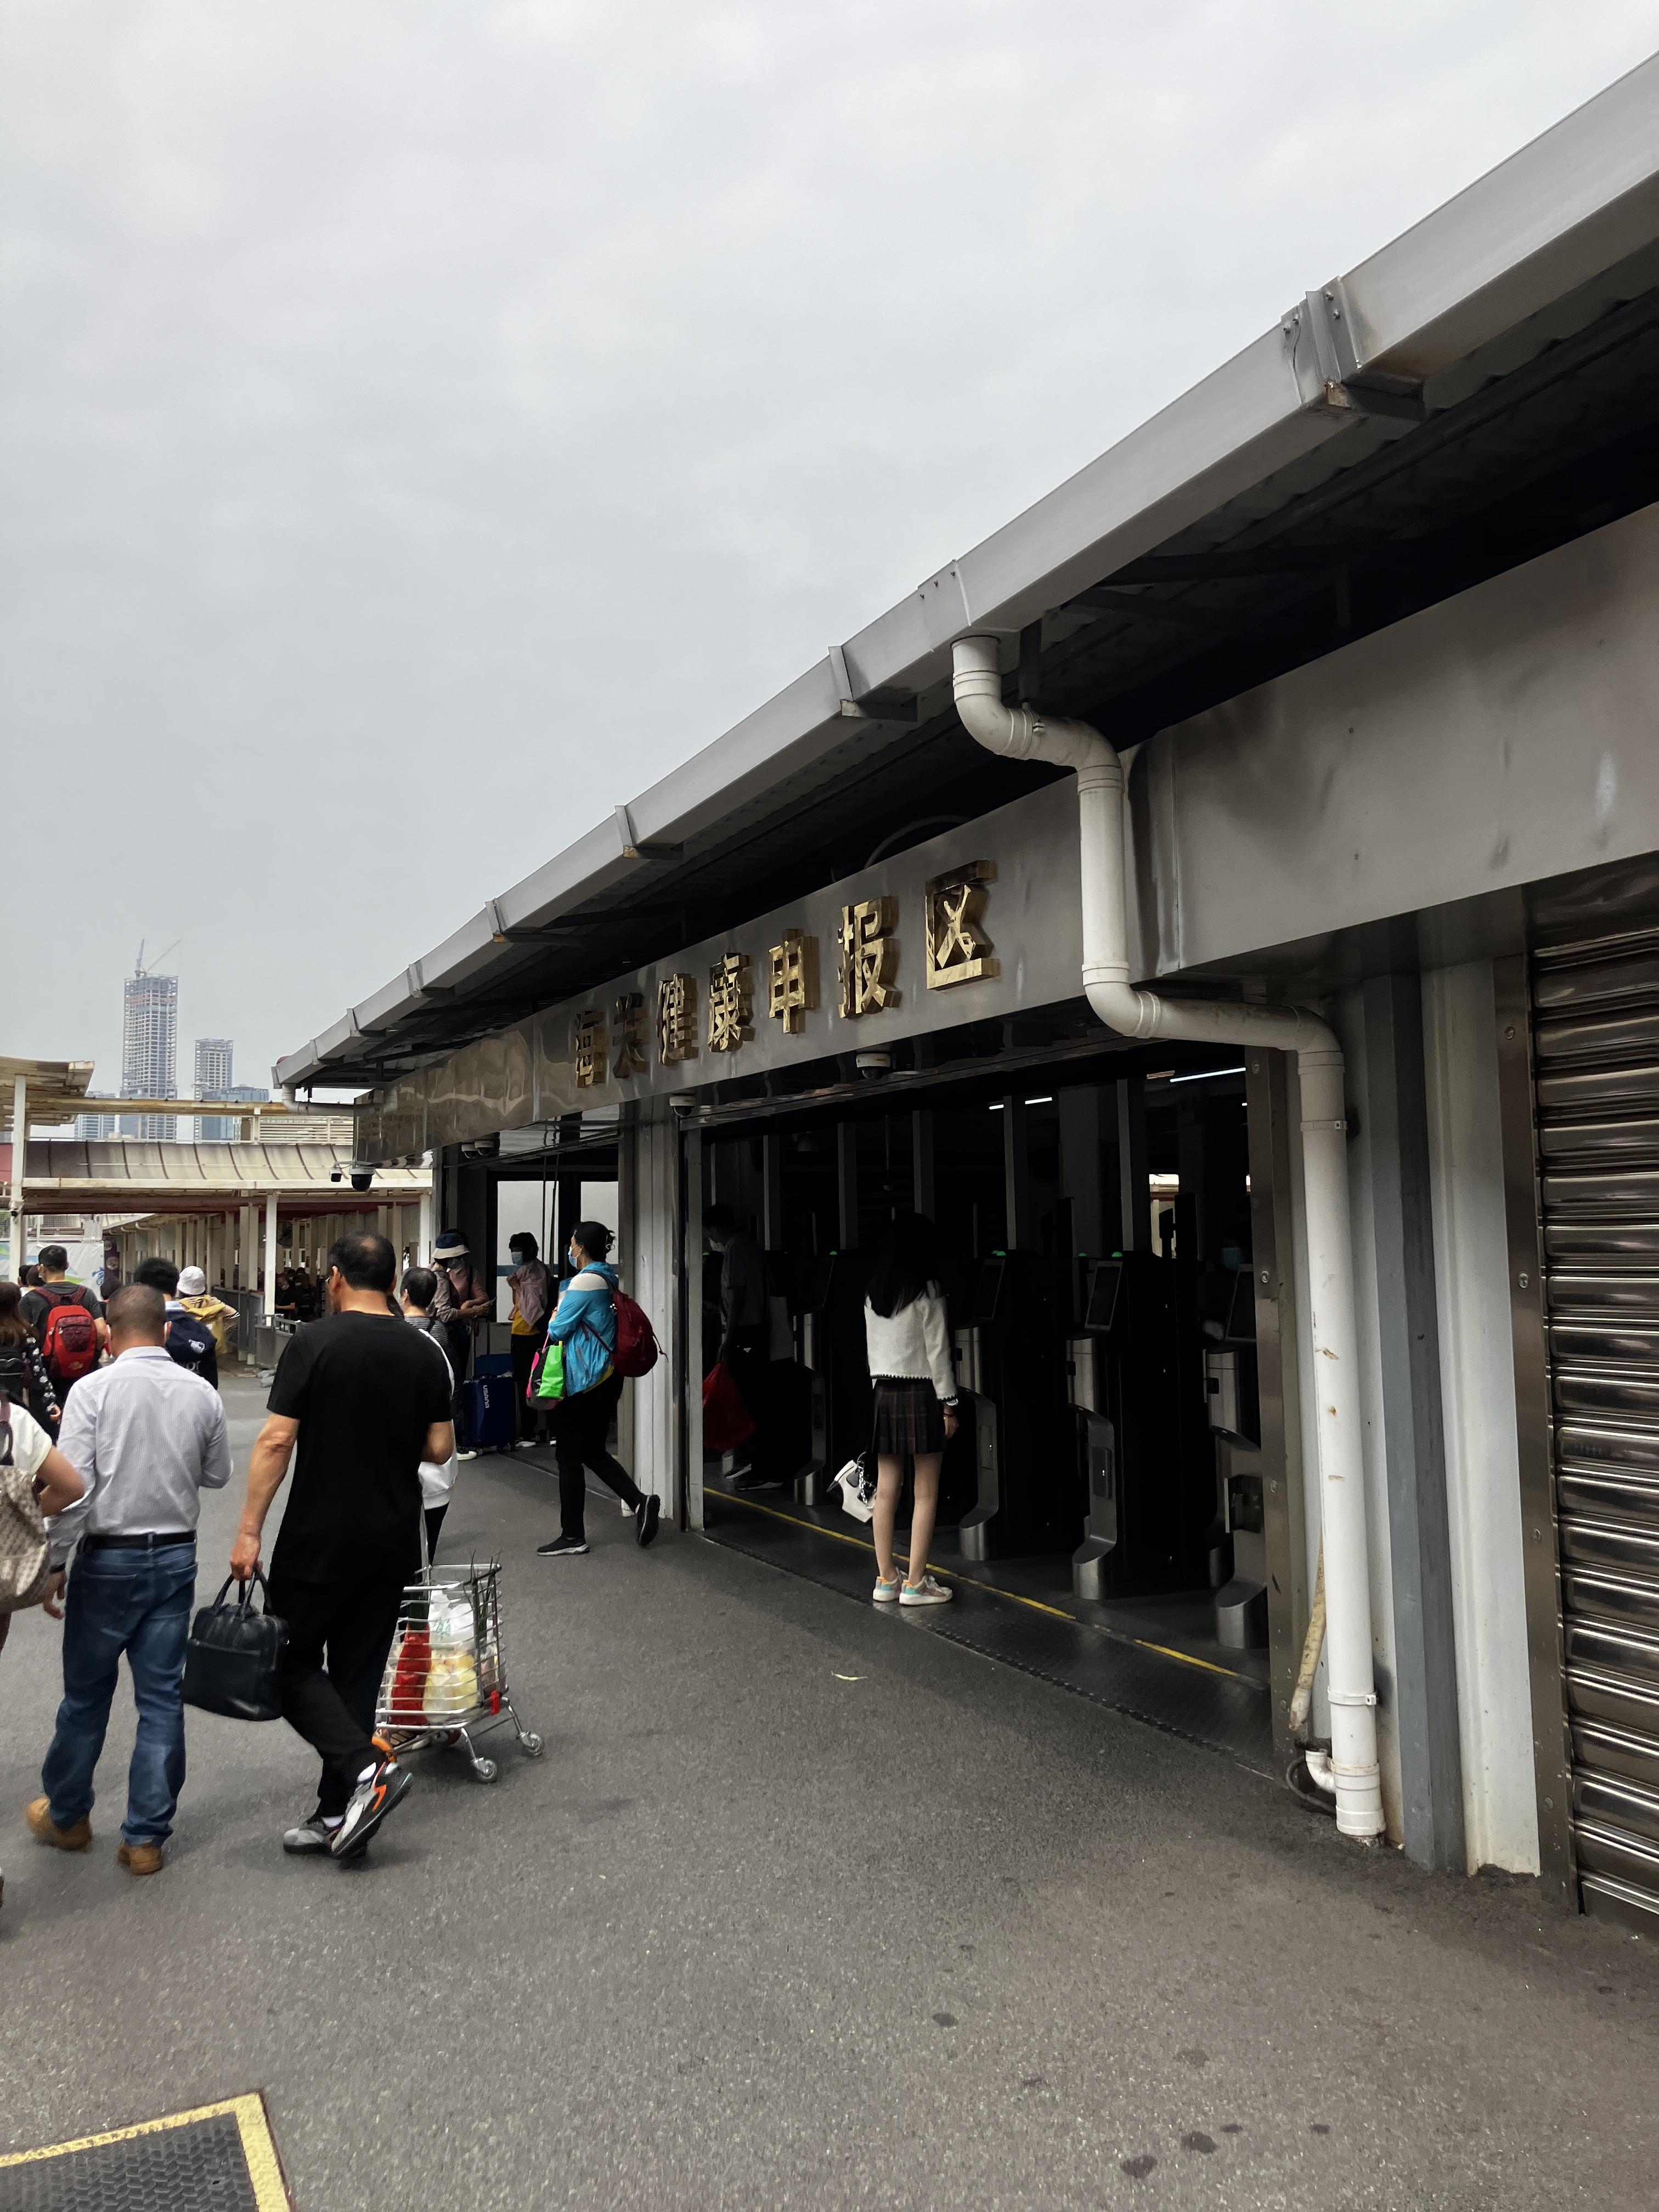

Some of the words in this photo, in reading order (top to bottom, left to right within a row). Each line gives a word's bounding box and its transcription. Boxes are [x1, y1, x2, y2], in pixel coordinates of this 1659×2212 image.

[575, 860, 998, 1088] 海关健康申报区
